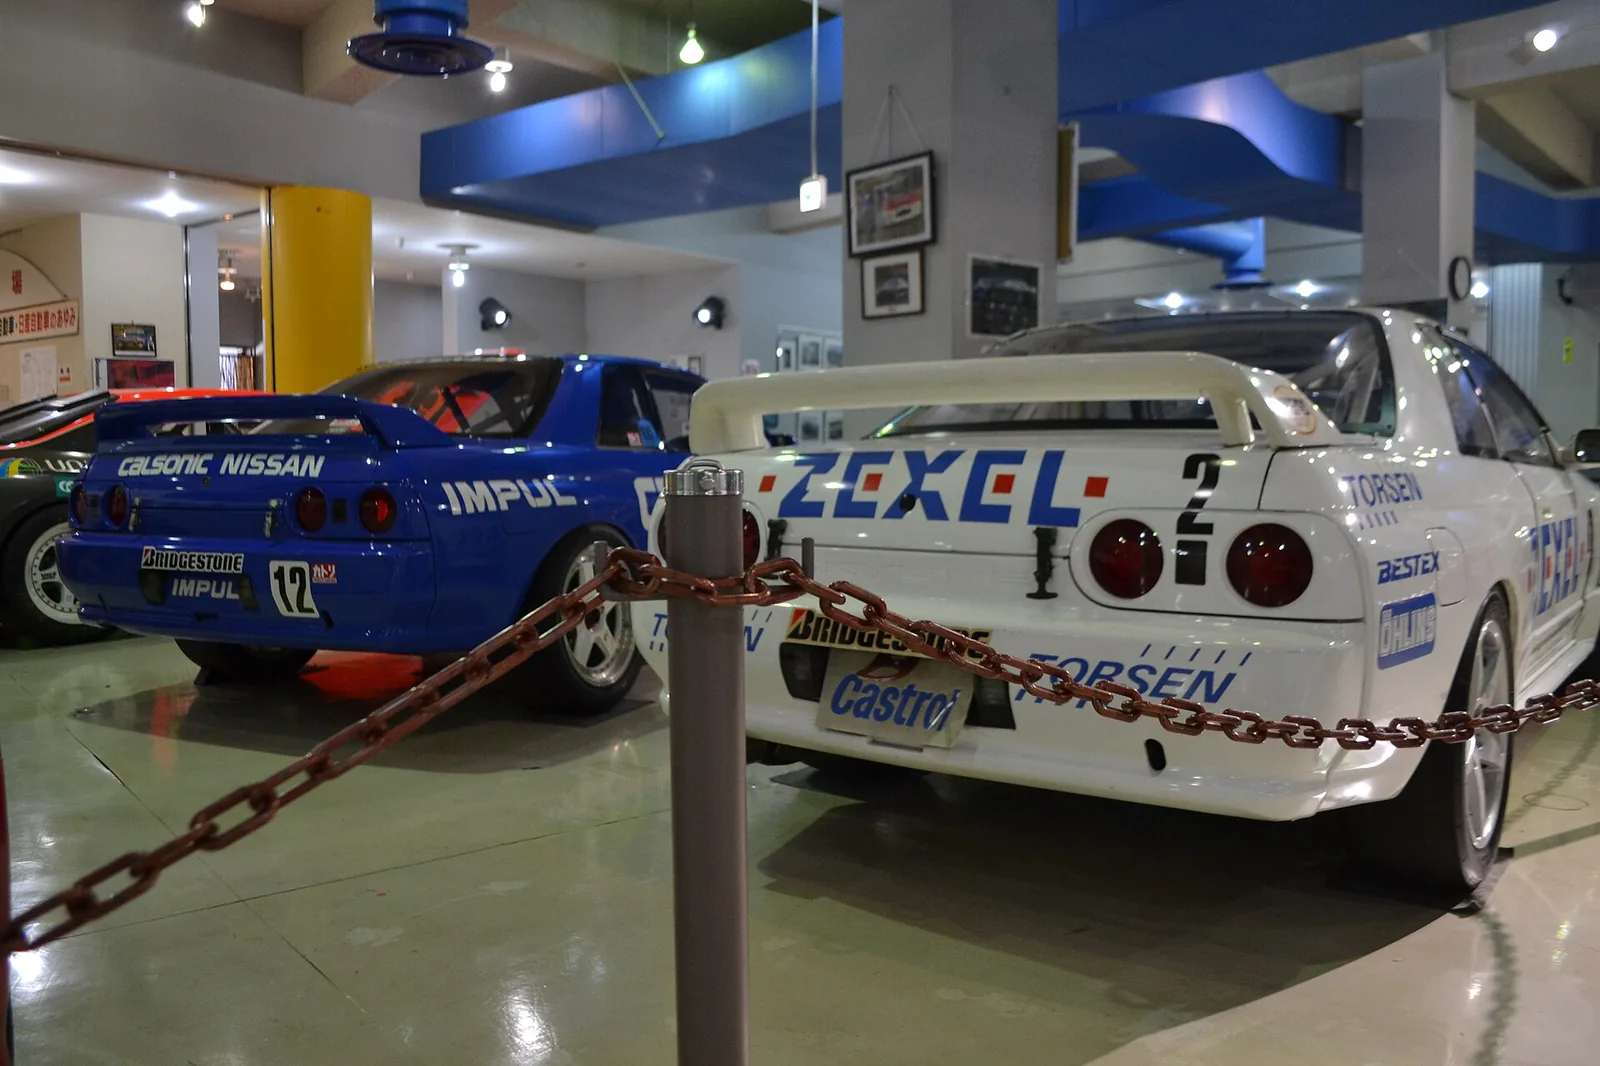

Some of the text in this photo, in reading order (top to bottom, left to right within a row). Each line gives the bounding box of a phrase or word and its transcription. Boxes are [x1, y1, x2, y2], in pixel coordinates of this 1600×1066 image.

[219, 453, 325, 478] NISSAN
[441, 478, 577, 515] IMPUL
[777, 450, 1082, 528] ZEXEL
[1176, 453, 1221, 535] 2
[1342, 473, 1424, 508] TORSEN
[142, 547, 244, 573] BRIDGESTONE
[1377, 550, 1440, 584] BESTEX
[172, 578, 240, 600] IMPUL
[274, 565, 316, 614] 12
[831, 673, 962, 732] Castrol
